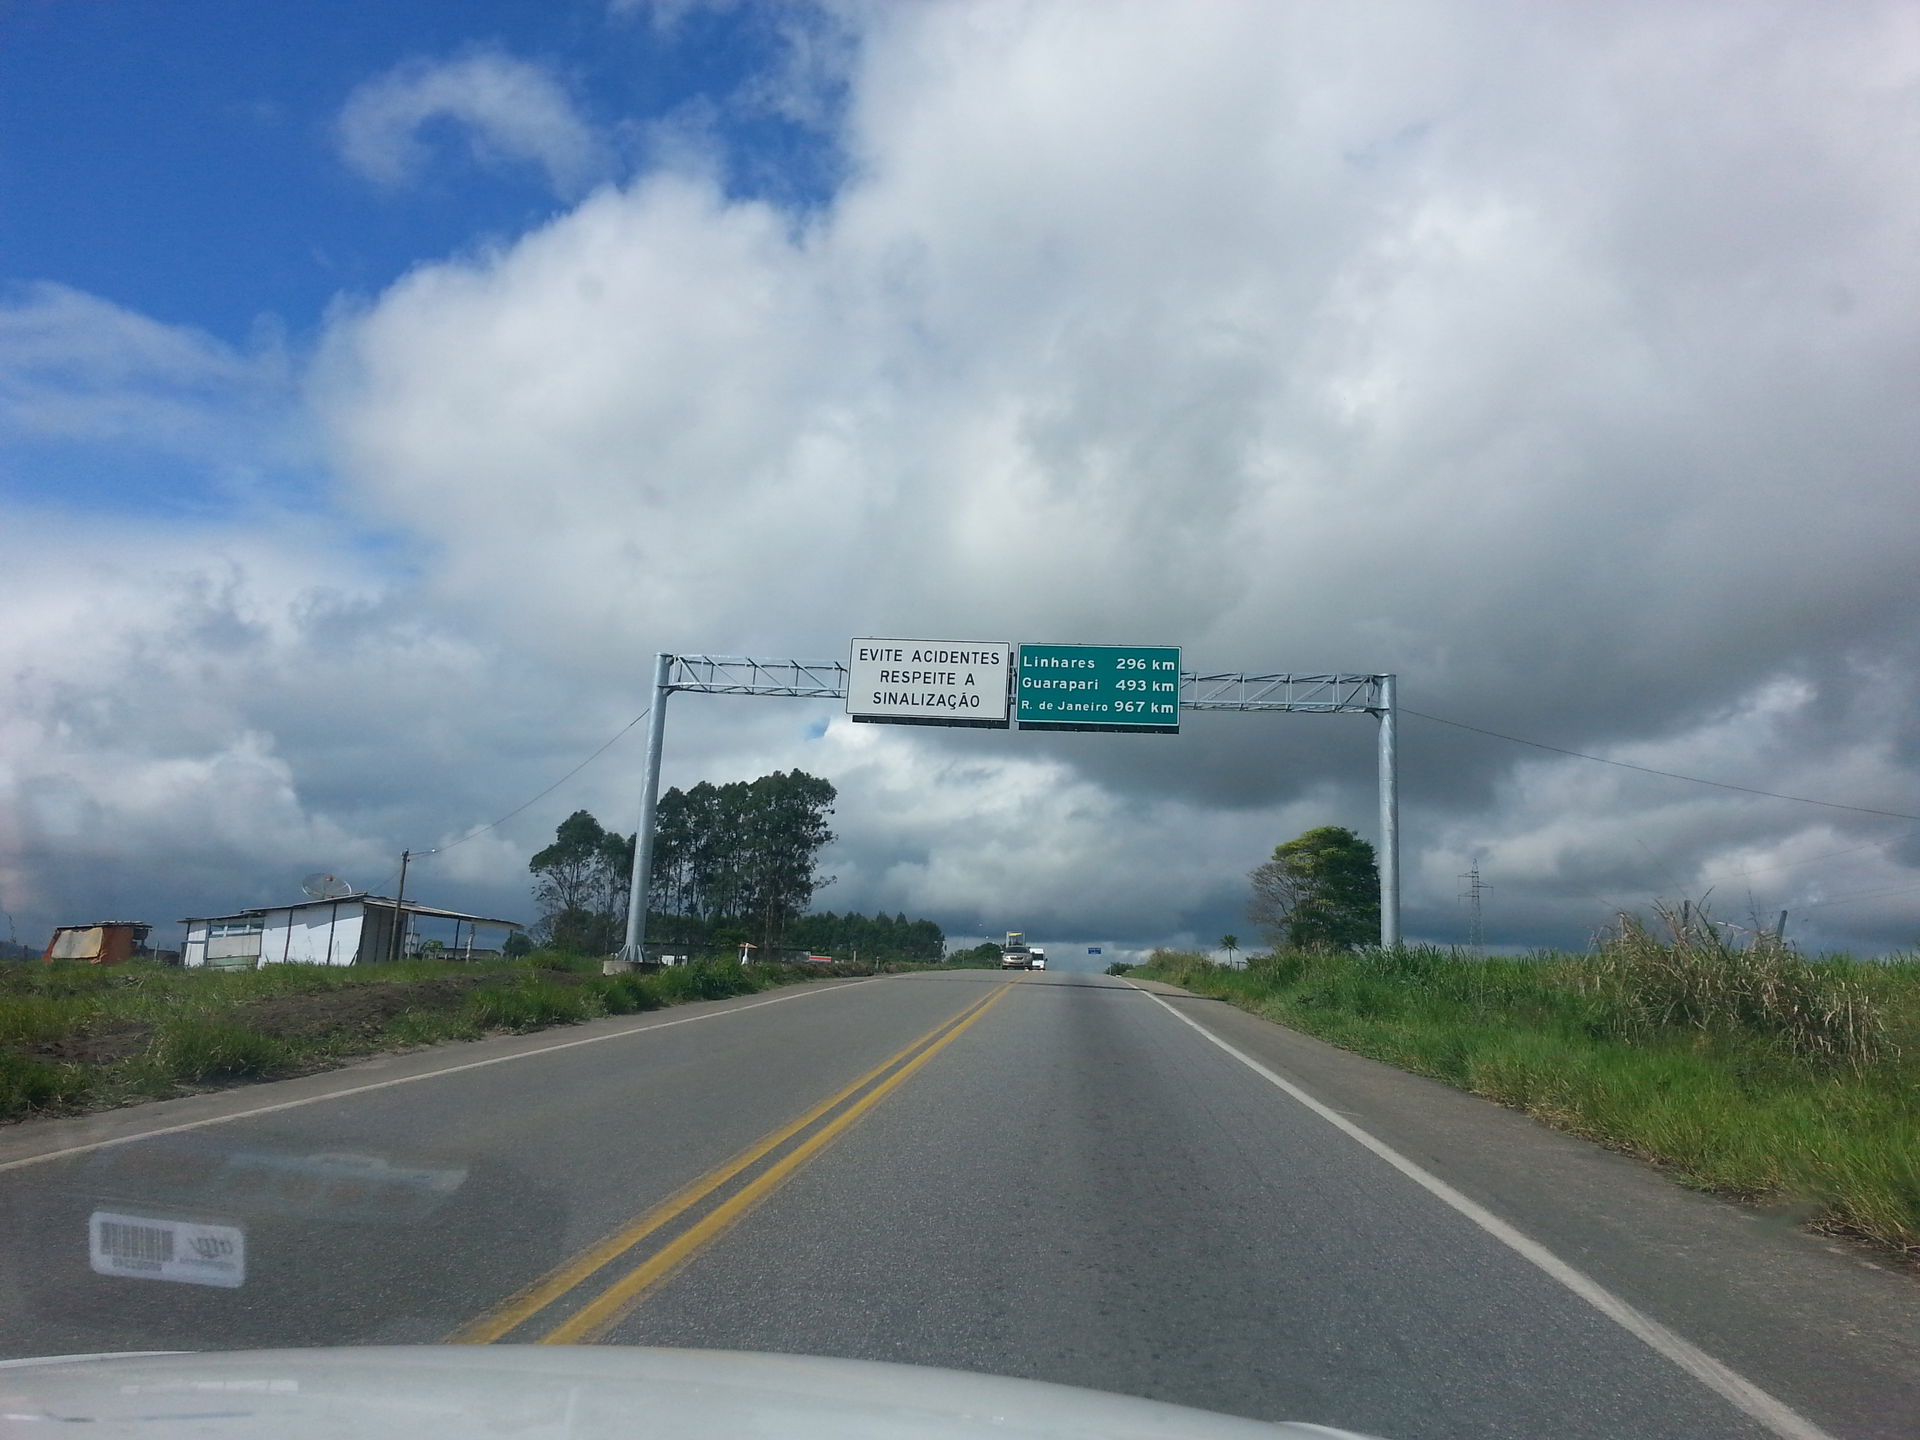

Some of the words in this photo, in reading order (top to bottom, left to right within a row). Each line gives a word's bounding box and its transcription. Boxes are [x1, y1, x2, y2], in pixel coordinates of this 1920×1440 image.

[860, 648, 902, 661] EVITE
[912, 650, 999, 664] ACIDENTES
[1023, 656, 1095, 668] Linhares
[1116, 659, 1145, 669] 296
[1152, 659, 1174, 670] km
[880, 671, 955, 684] RESPEITE
[965, 674, 974, 685] A
[1022, 677, 1098, 691] Guarapari
[1115, 680, 1146, 691] 493
[1152, 681, 1174, 692] km
[873, 692, 979, 710] SINALIZAÇÃO
[1021, 700, 1033, 710] R.
[1039, 701, 1052, 711] de
[1057, 701, 1108, 711] Janeiro
[1114, 701, 1145, 712] 967
[1151, 702, 1174, 713] km
